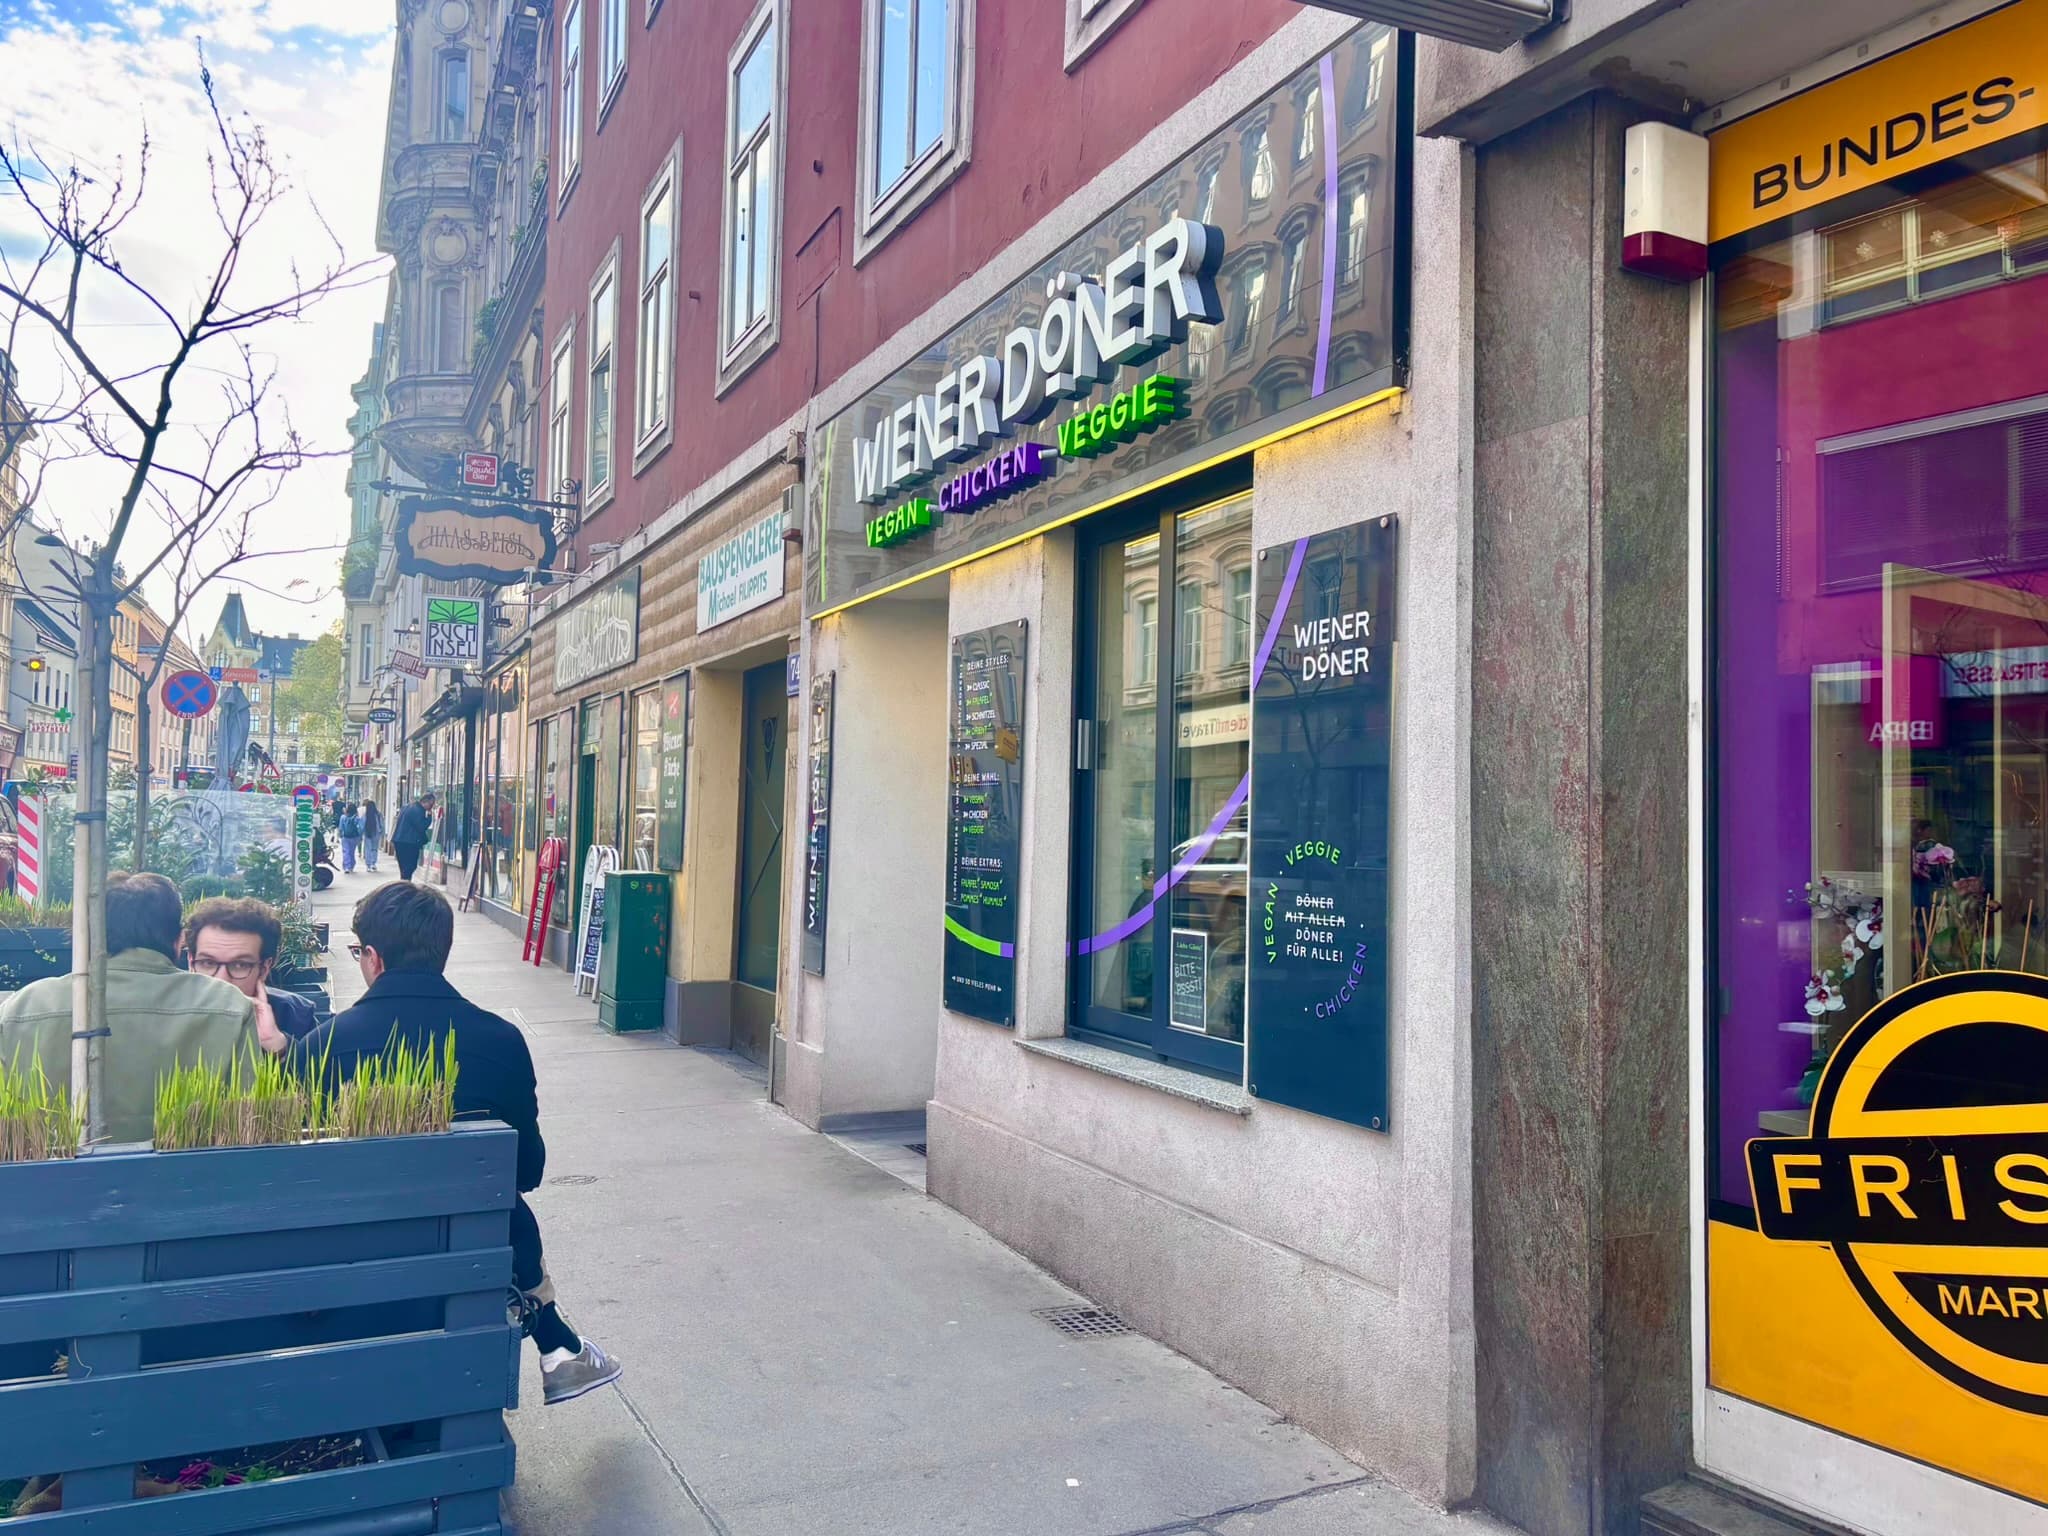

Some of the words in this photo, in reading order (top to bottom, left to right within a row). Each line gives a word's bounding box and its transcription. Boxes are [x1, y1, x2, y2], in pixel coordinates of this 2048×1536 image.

[1753, 77, 2035, 209] BUNDES-
[853, 354, 999, 504] WIENER
[1002, 216, 1209, 422] DÖNER
[866, 499, 920, 547] VEGAN
[938, 444, 1028, 513] CHICKEN
[1057, 375, 1163, 457] VEGGIE
[708, 584, 737, 625] Michael
[429, 624, 476, 642] BUCH
[1294, 610, 1370, 649] WIENER
[428, 640, 477, 657] INSEL
[967, 658, 984, 671] DEINE
[986, 654, 1009, 668] STYLES:
[1303, 647, 1369, 681] DÖNER
[177, 711, 196, 720] ENDE
[971, 709, 996, 721] SCHNITZEL
[32, 722, 69, 733] APOTHEKE
[963, 772, 980, 783] DEINE
[968, 809, 989, 820] CHICKEN
[968, 824, 985, 834] VEGGIE
[1285, 841, 1341, 866] VEGGIE
[961, 857, 978, 867] DEINE
[979, 857, 1003, 869] EXTRAS:
[808, 821, 818, 929] WIENER
[1296, 894, 1334, 910] DÖNER
[1264, 882, 1280, 963] VEGAN
[1285, 911, 1304, 924] MIT
[1308, 913, 1346, 928] ALLEM
[1296, 928, 1334, 944] DÖNER
[1286, 942, 1307, 958] FÜR
[1311, 947, 1344, 963] ALLE!
[1175, 962, 1196, 978] BITTE
[1315, 942, 1368, 1018] CHICKEN
[1772, 1152, 2048, 1225] FRIS
[1937, 1284, 2048, 1320] MAR
